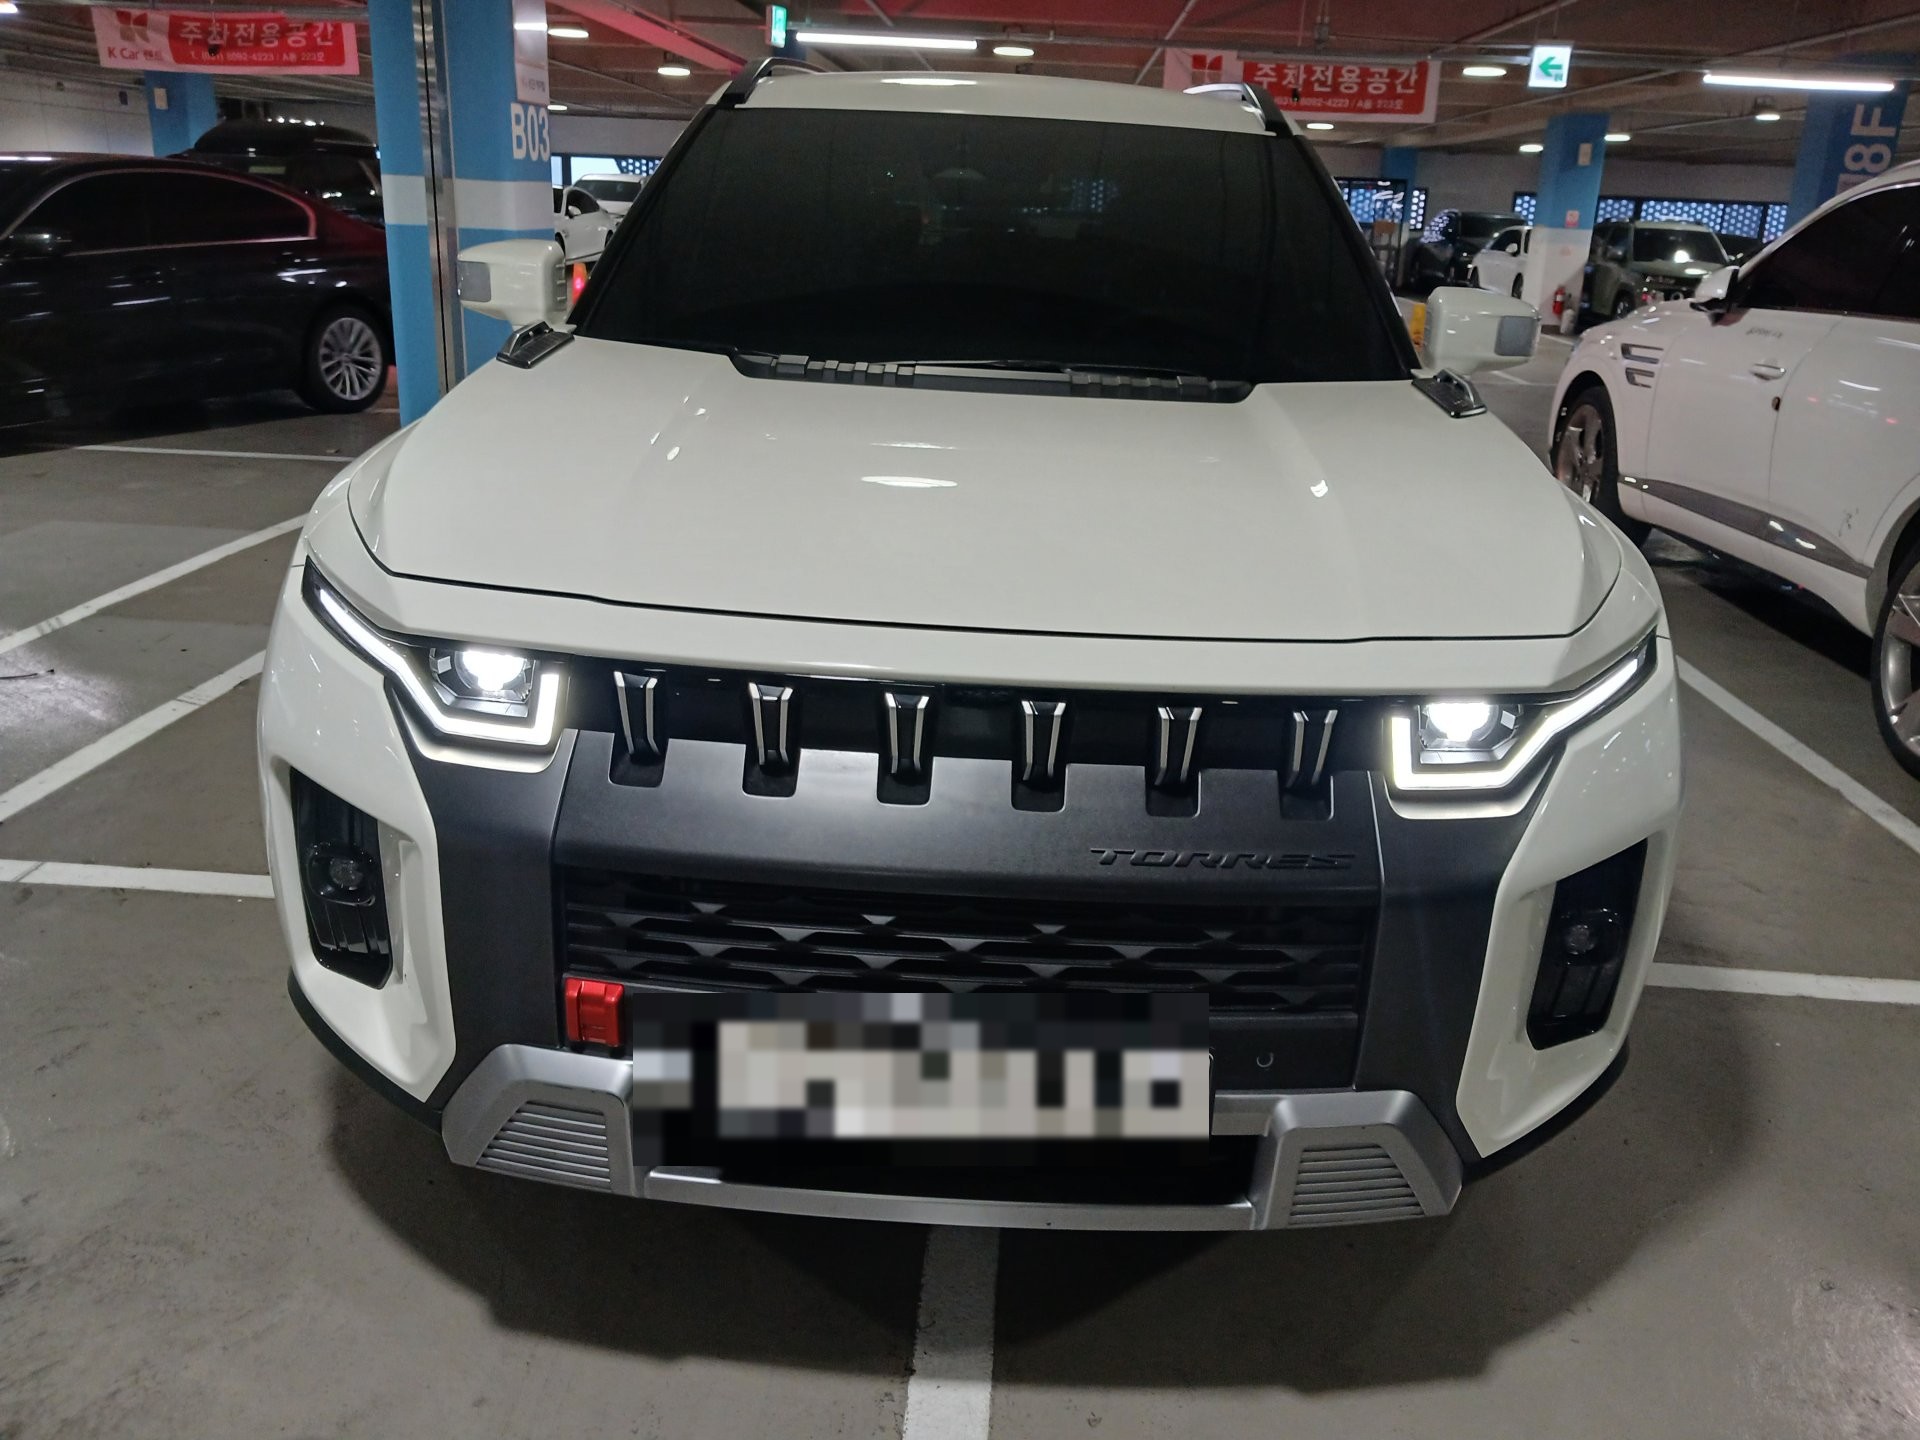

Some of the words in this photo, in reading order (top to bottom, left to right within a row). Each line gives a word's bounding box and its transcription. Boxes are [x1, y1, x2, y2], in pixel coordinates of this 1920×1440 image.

[179, 20, 334, 48] 주차전용공간
[107, 46, 117, 58] K
[119, 47, 139, 60] Car
[1253, 62, 1419, 94] 주차전용공간
[511, 102, 550, 162] B03
[1090, 848, 1356, 870] TORRES
